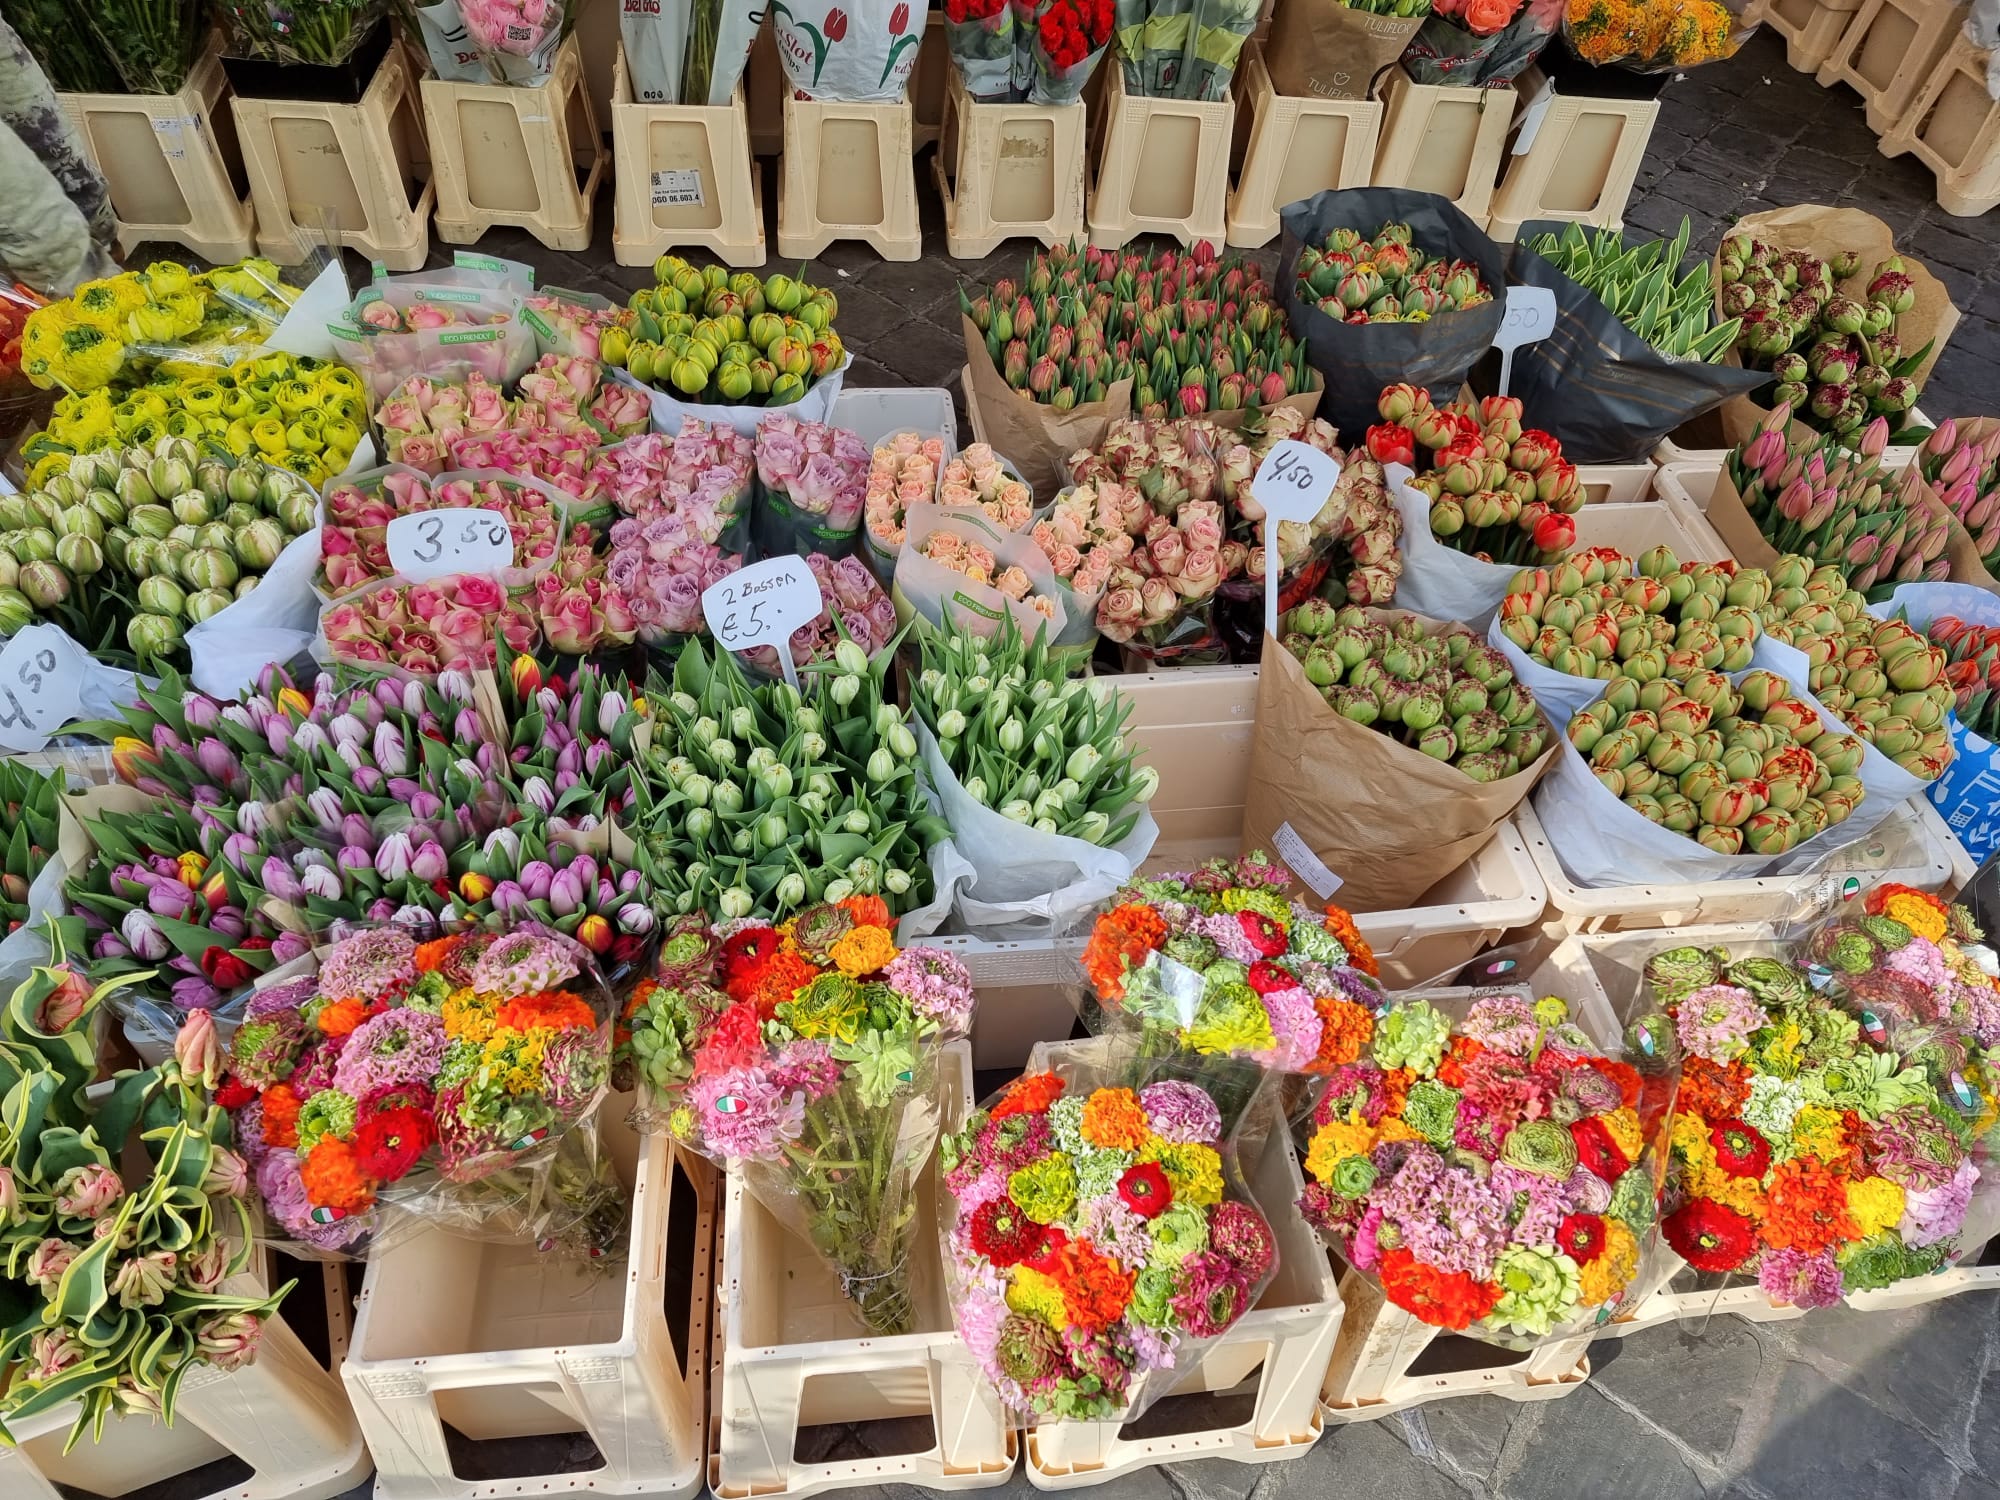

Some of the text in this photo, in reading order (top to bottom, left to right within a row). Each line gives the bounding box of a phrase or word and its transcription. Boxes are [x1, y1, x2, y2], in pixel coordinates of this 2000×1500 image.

[1364, 16, 1412, 34] TULIFLOR
[443, 332, 491, 344] ECO FRIENDLY
[721, 588, 737, 606] 2
[957, 595, 974, 608] ECO
